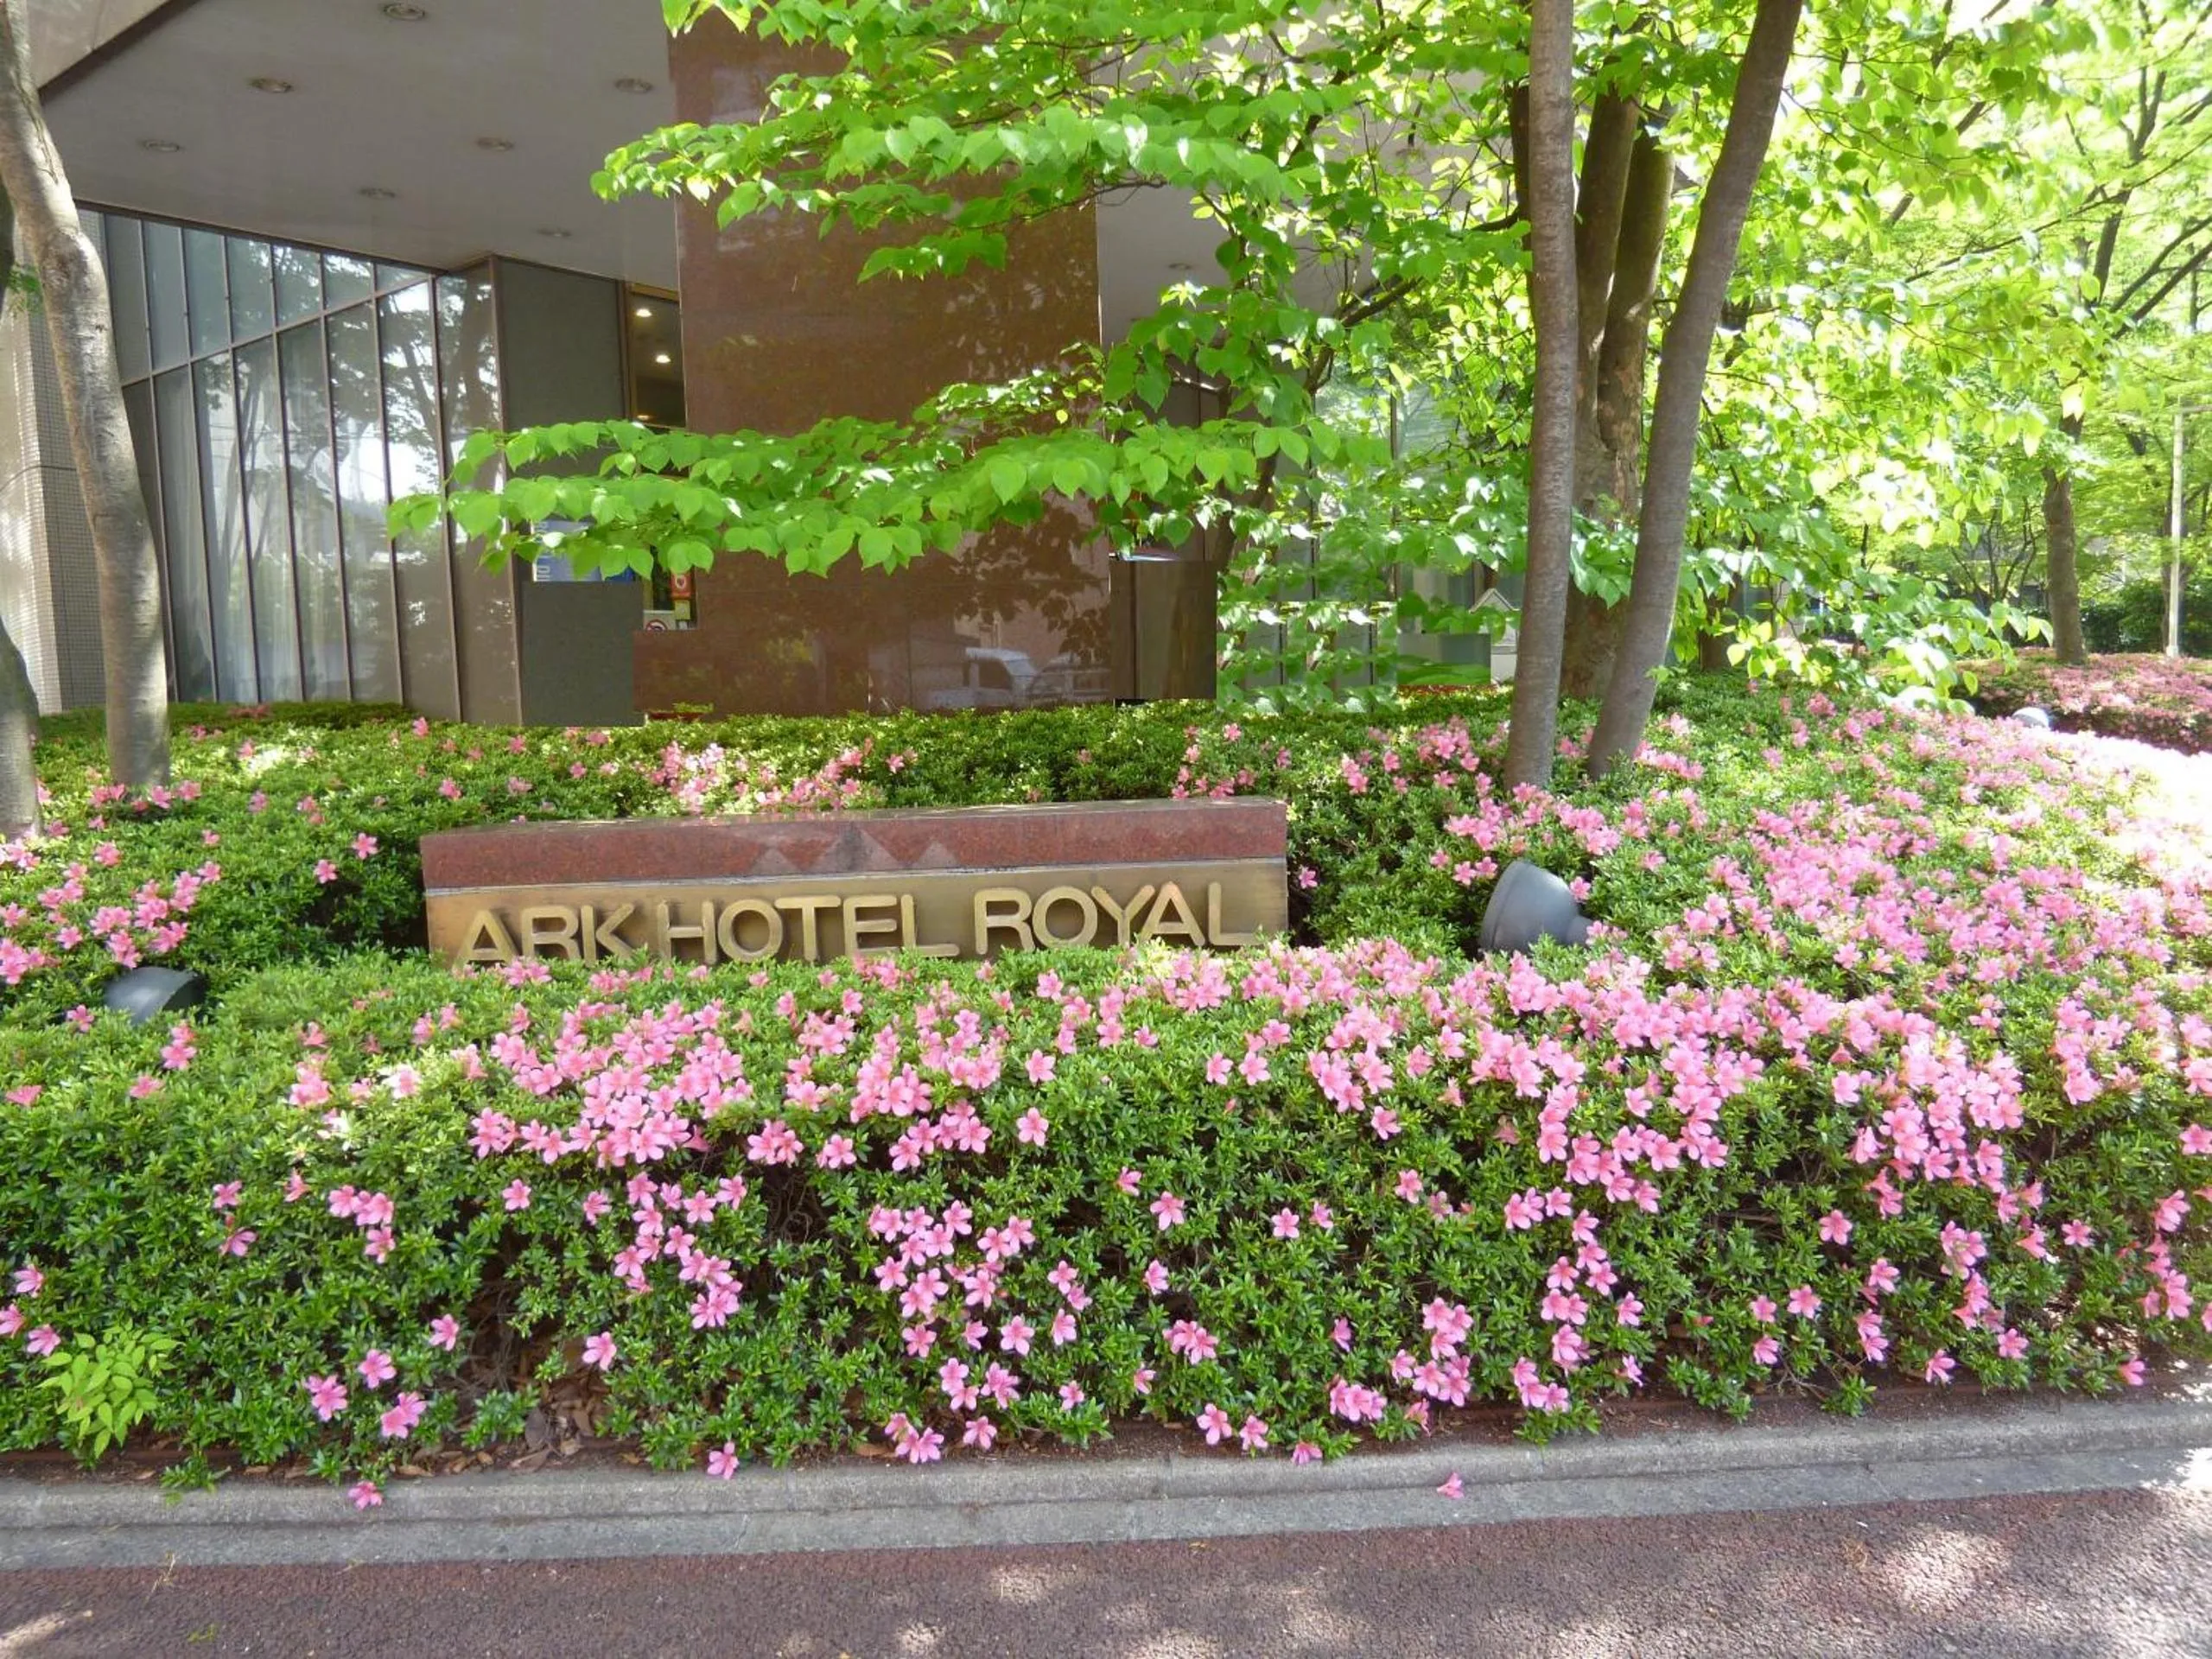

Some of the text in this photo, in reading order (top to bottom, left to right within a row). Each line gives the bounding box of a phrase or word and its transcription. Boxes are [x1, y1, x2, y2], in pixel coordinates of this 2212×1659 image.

[454, 880, 1270, 965] ARK HOTEL ROYAL
